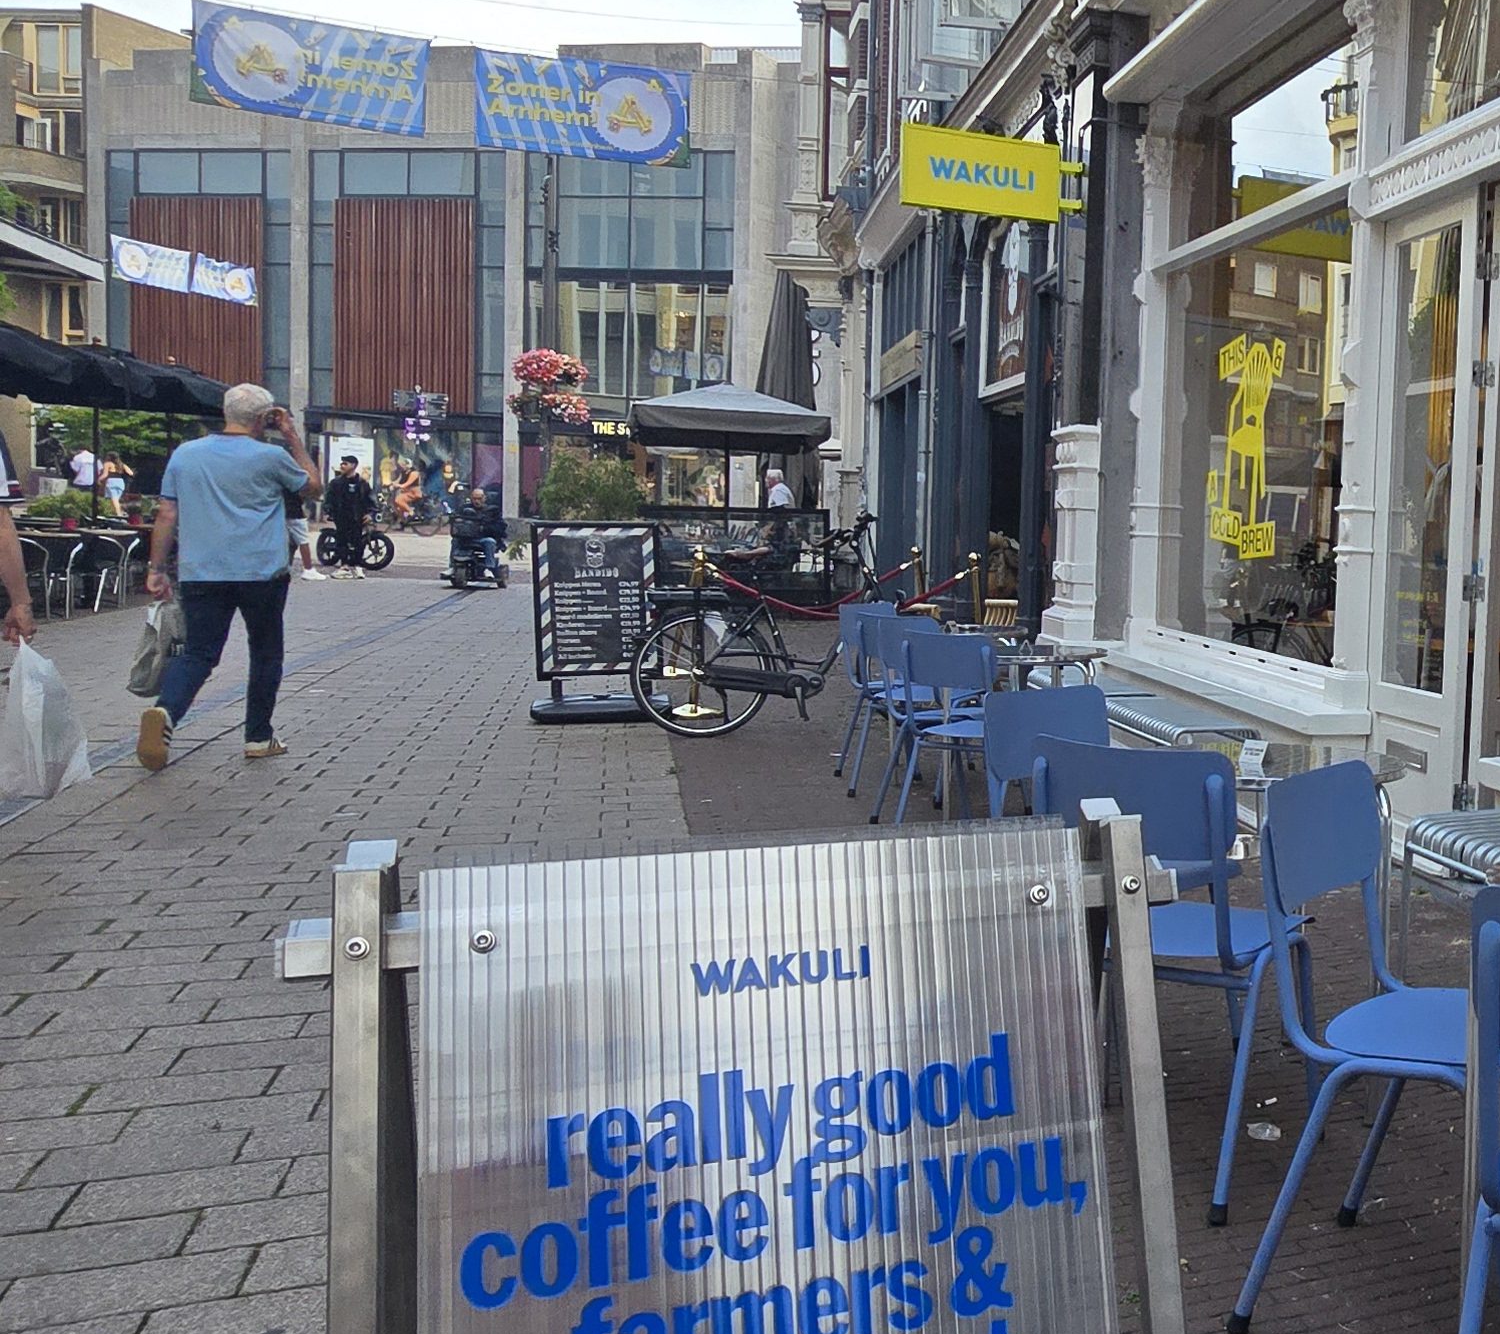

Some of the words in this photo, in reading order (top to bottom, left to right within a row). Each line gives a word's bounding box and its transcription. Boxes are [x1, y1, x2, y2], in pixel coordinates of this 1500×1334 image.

[487, 73, 571, 101] Zomer
[578, 84, 602, 107] in
[929, 155, 1035, 191] WAKULI
[1221, 338, 1245, 374] THIS
[1273, 343, 1283, 371] &
[592, 421, 616, 435] THE
[1212, 511, 1241, 540] COLD
[1241, 523, 1274, 555] BREW
[691, 945, 873, 997] WAKULI
[545, 1069, 792, 1189] really
[813, 1033, 1015, 1165] good
[460, 1181, 769, 1309] coffee
[783, 1155, 911, 1251] for
[923, 1135, 1088, 1245] you,
[950, 1225, 1013, 1317] &
